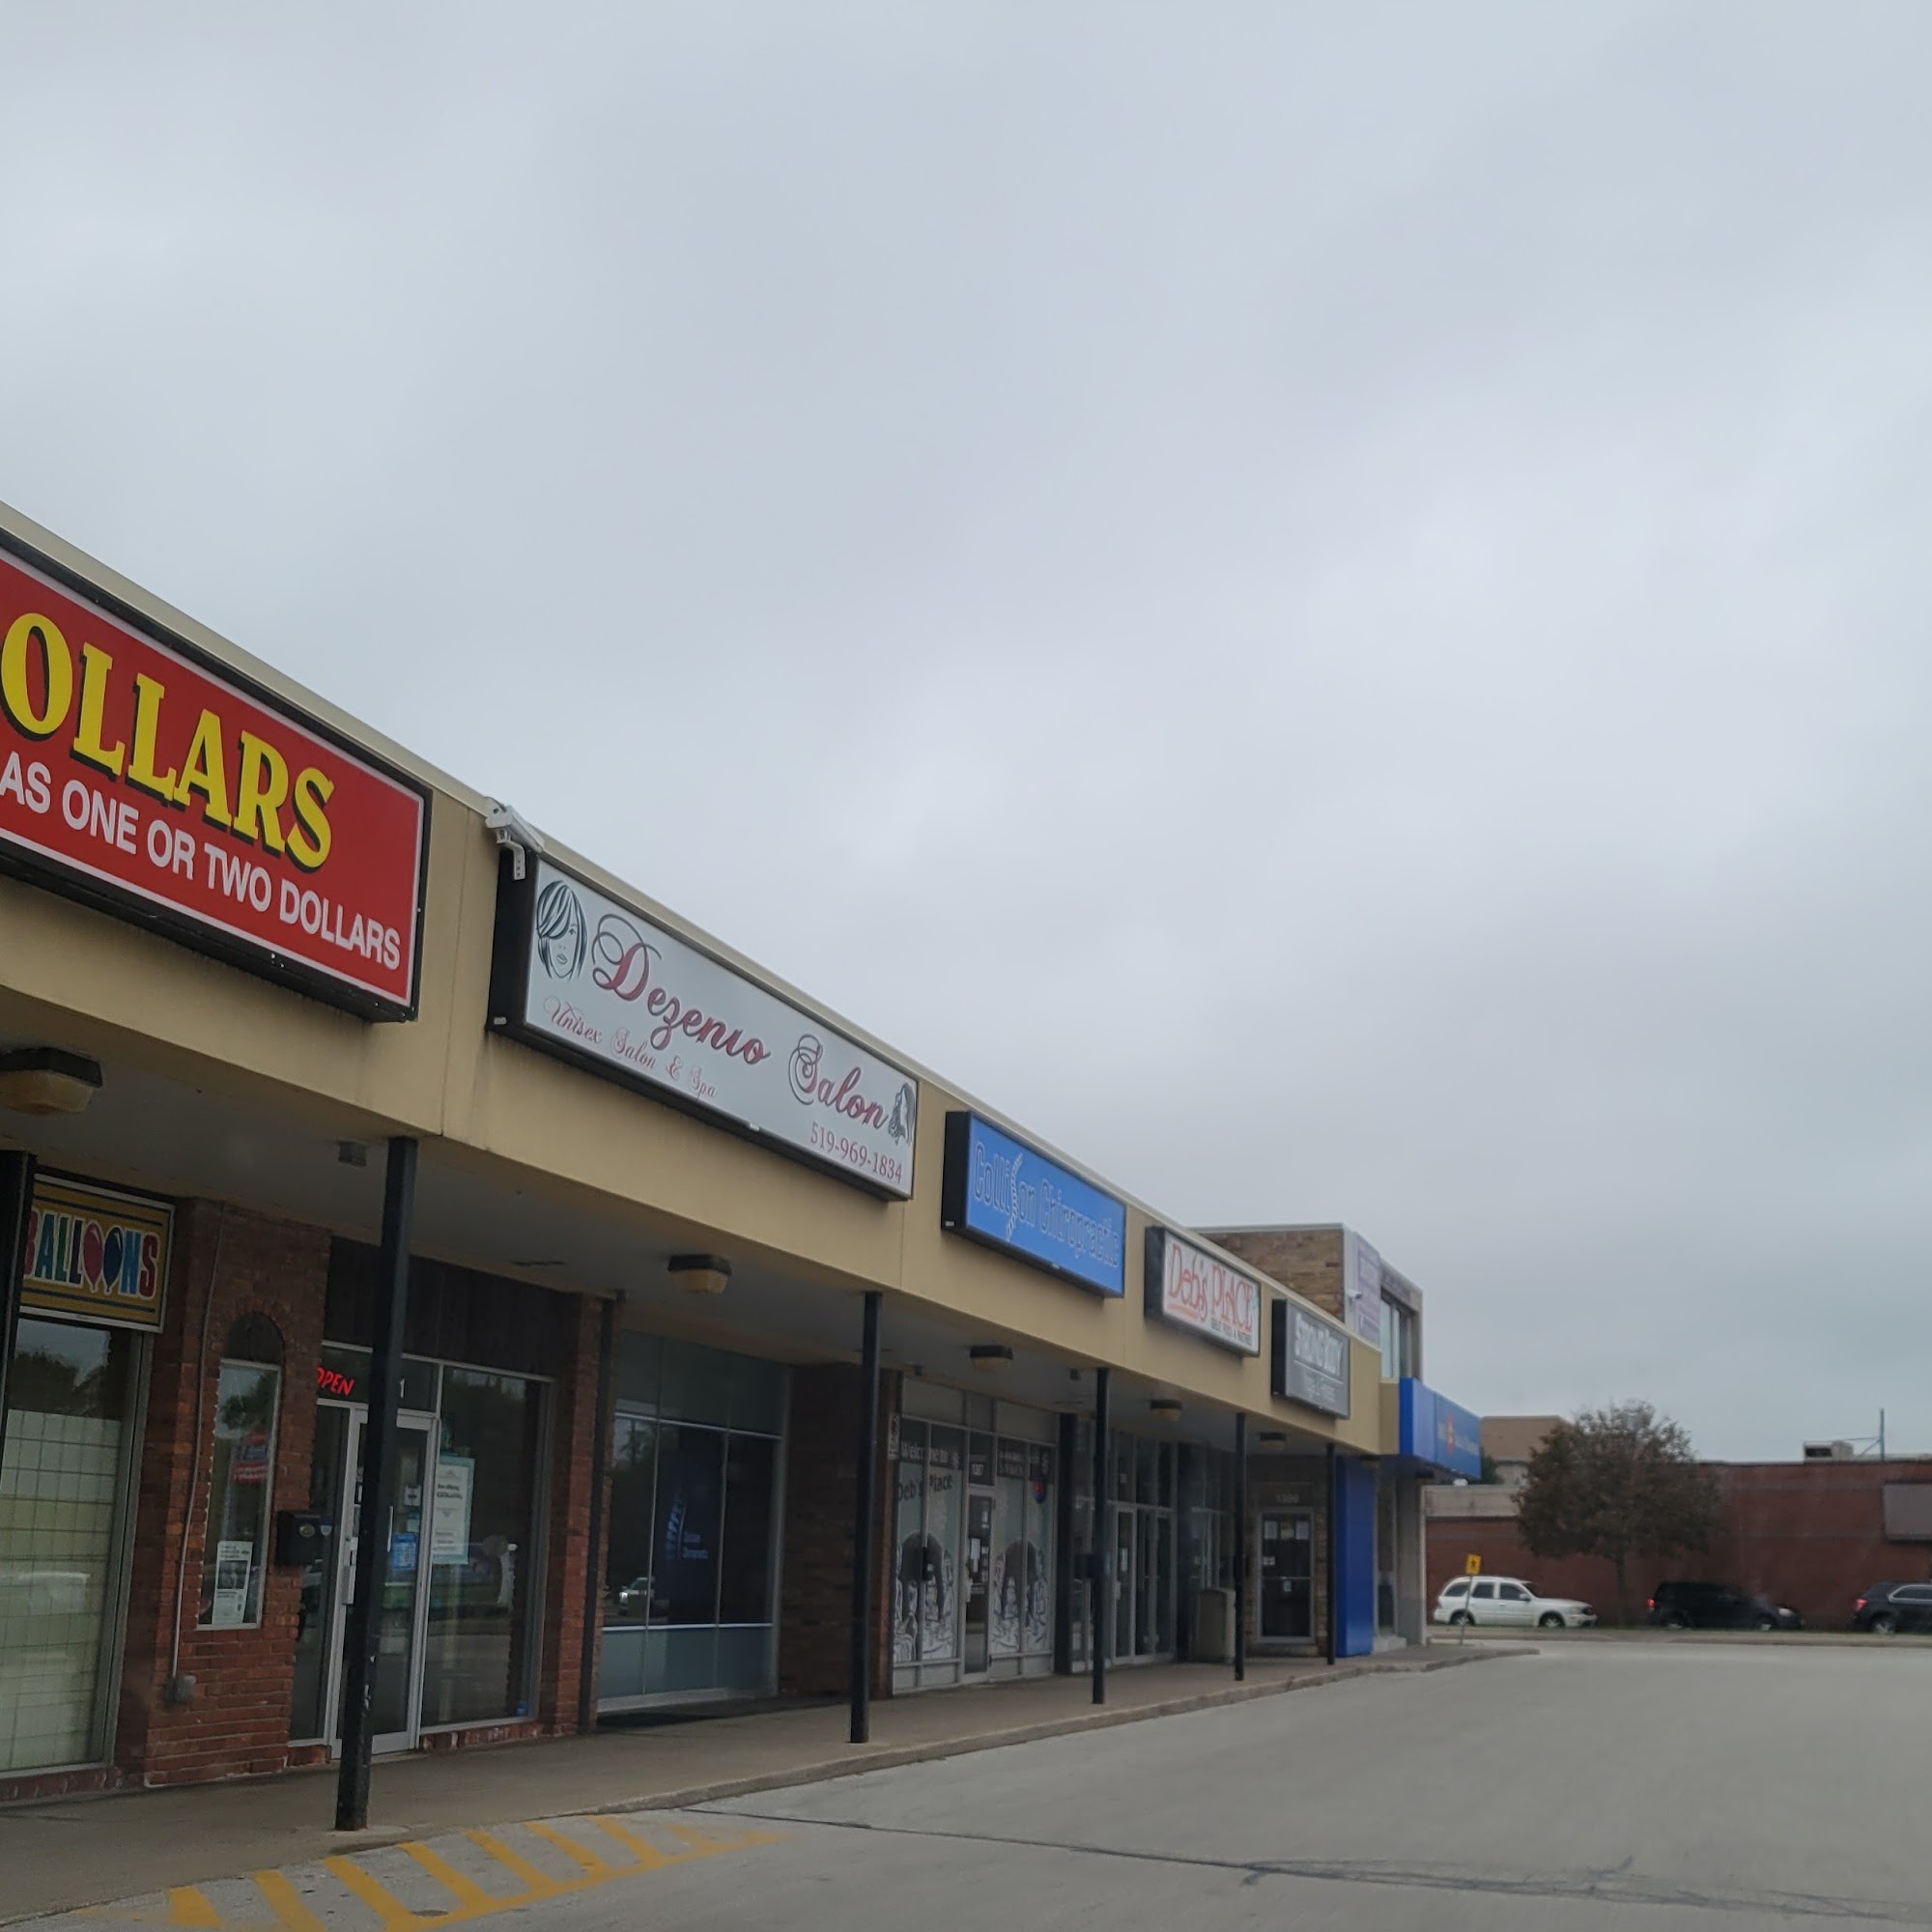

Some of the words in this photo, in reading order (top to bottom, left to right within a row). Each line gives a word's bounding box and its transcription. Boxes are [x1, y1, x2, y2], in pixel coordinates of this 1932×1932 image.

[0, 611, 335, 871] OLLARS
[0, 752, 52, 814] AS
[62, 780, 139, 856] ONE
[147, 820, 195, 880] OR
[204, 842, 272, 913] TWO
[279, 879, 401, 971] DOLLARS
[542, 995, 605, 1044] Unisex
[611, 1026, 657, 1070] Salon
[667, 1053, 685, 1082] &
[688, 1064, 717, 1101] Spa
[591, 913, 772, 1065] Dezenio
[787, 1034, 890, 1130] Salon
[810, 1121, 903, 1184] 519-969-1834
[23, 1206, 160, 1300] BALLOONS
[1039, 1179, 1121, 1268] Chiropractic
